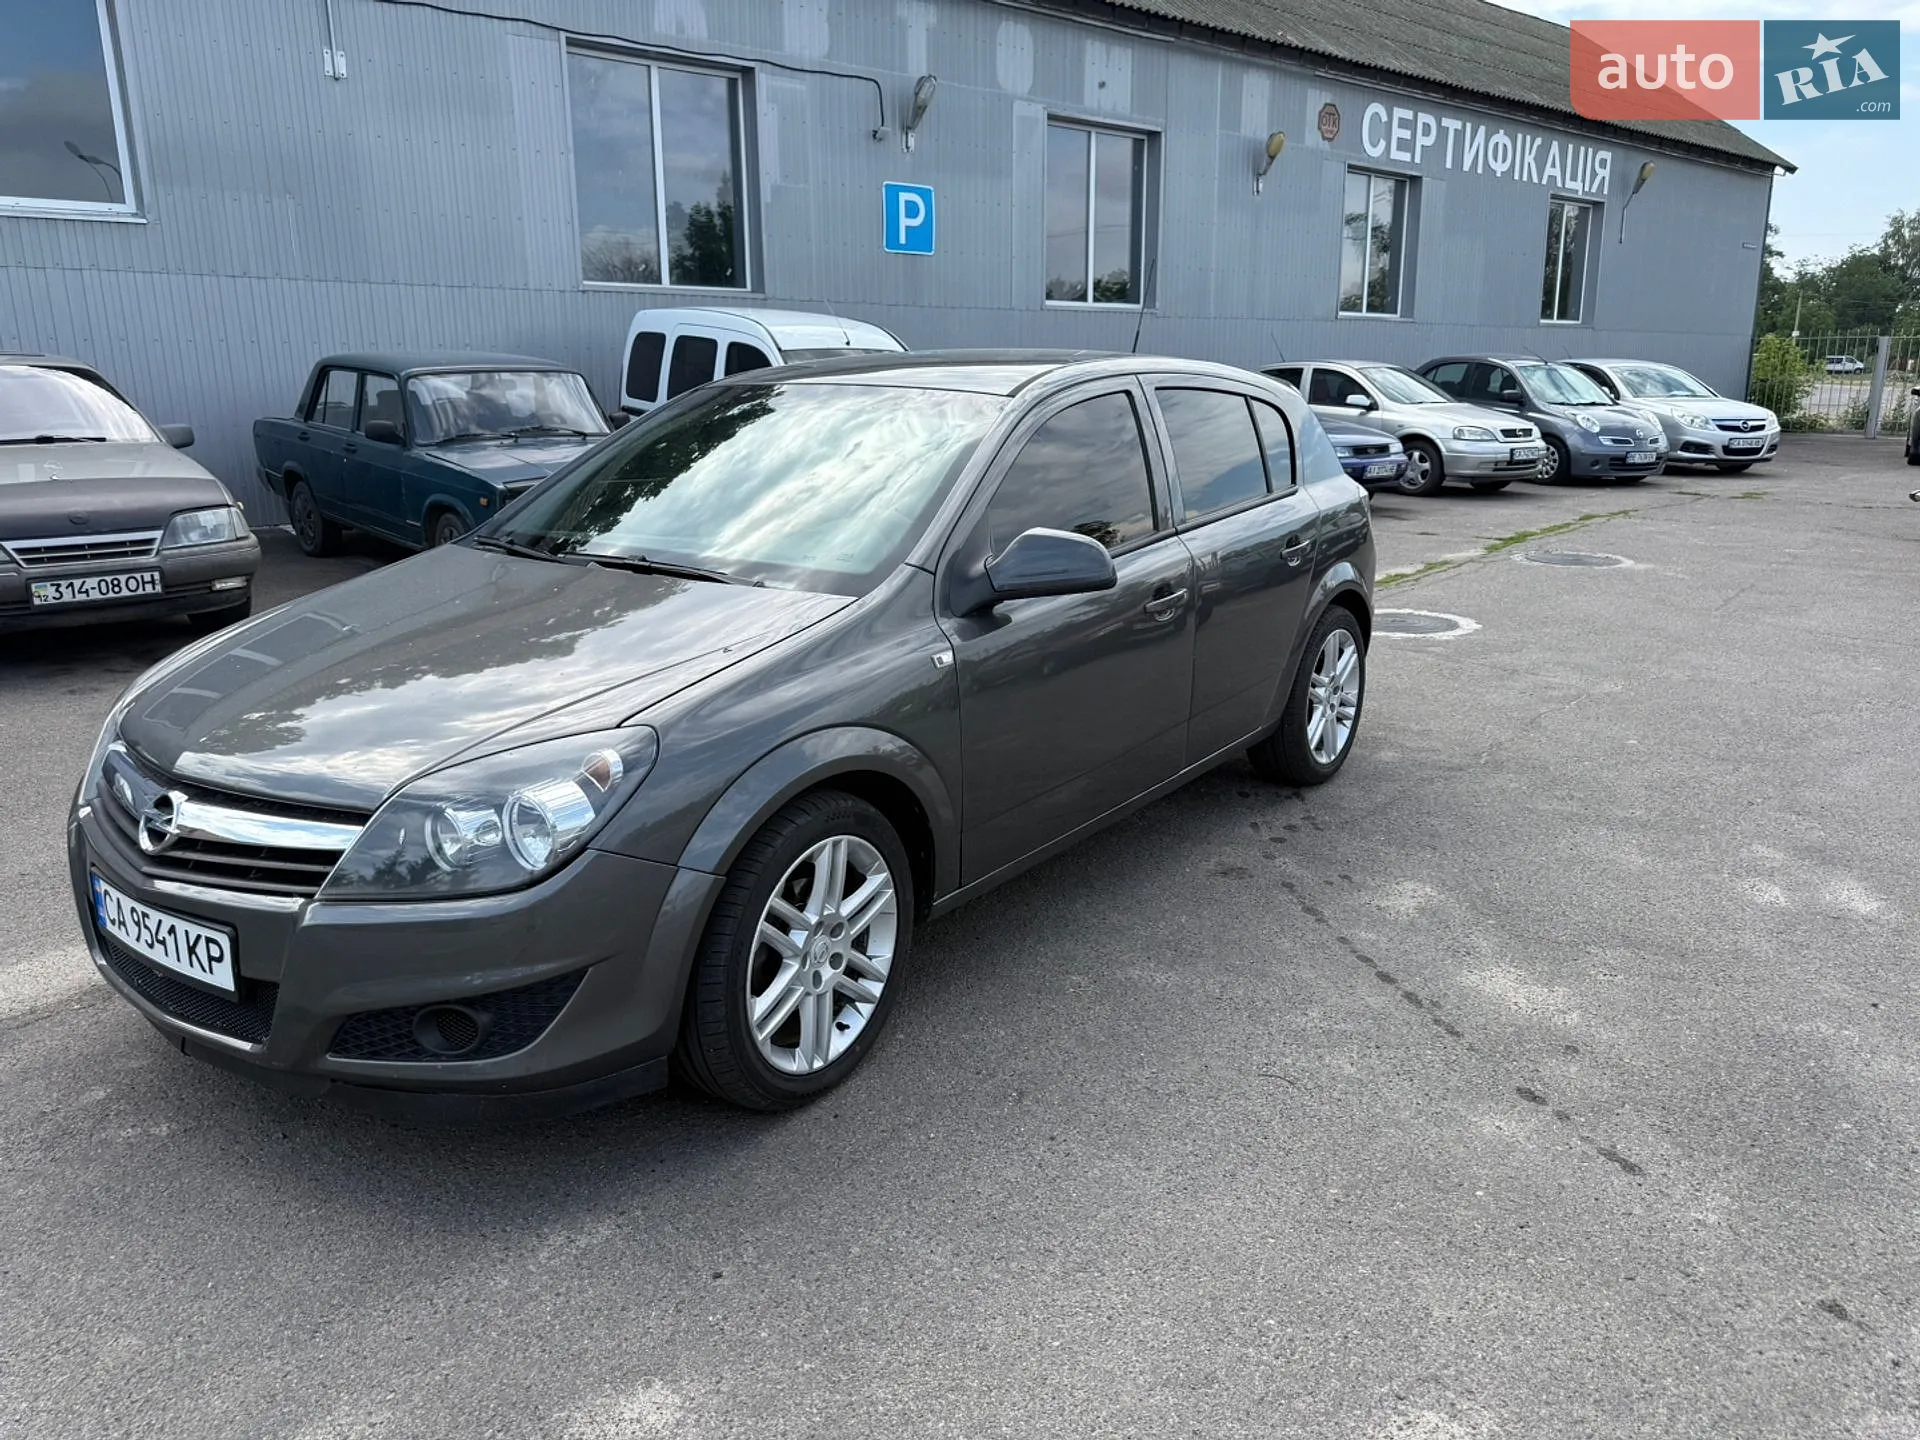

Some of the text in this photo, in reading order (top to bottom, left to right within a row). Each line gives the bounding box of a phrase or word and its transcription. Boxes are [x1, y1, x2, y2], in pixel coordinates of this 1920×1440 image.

[1361, 101, 1612, 196] СЕРТИФІКАЦІЯ
[898, 191, 926, 245] P
[50, 574, 157, 600] 314-08 OH
[103, 888, 224, 975] CA 9541 KP
